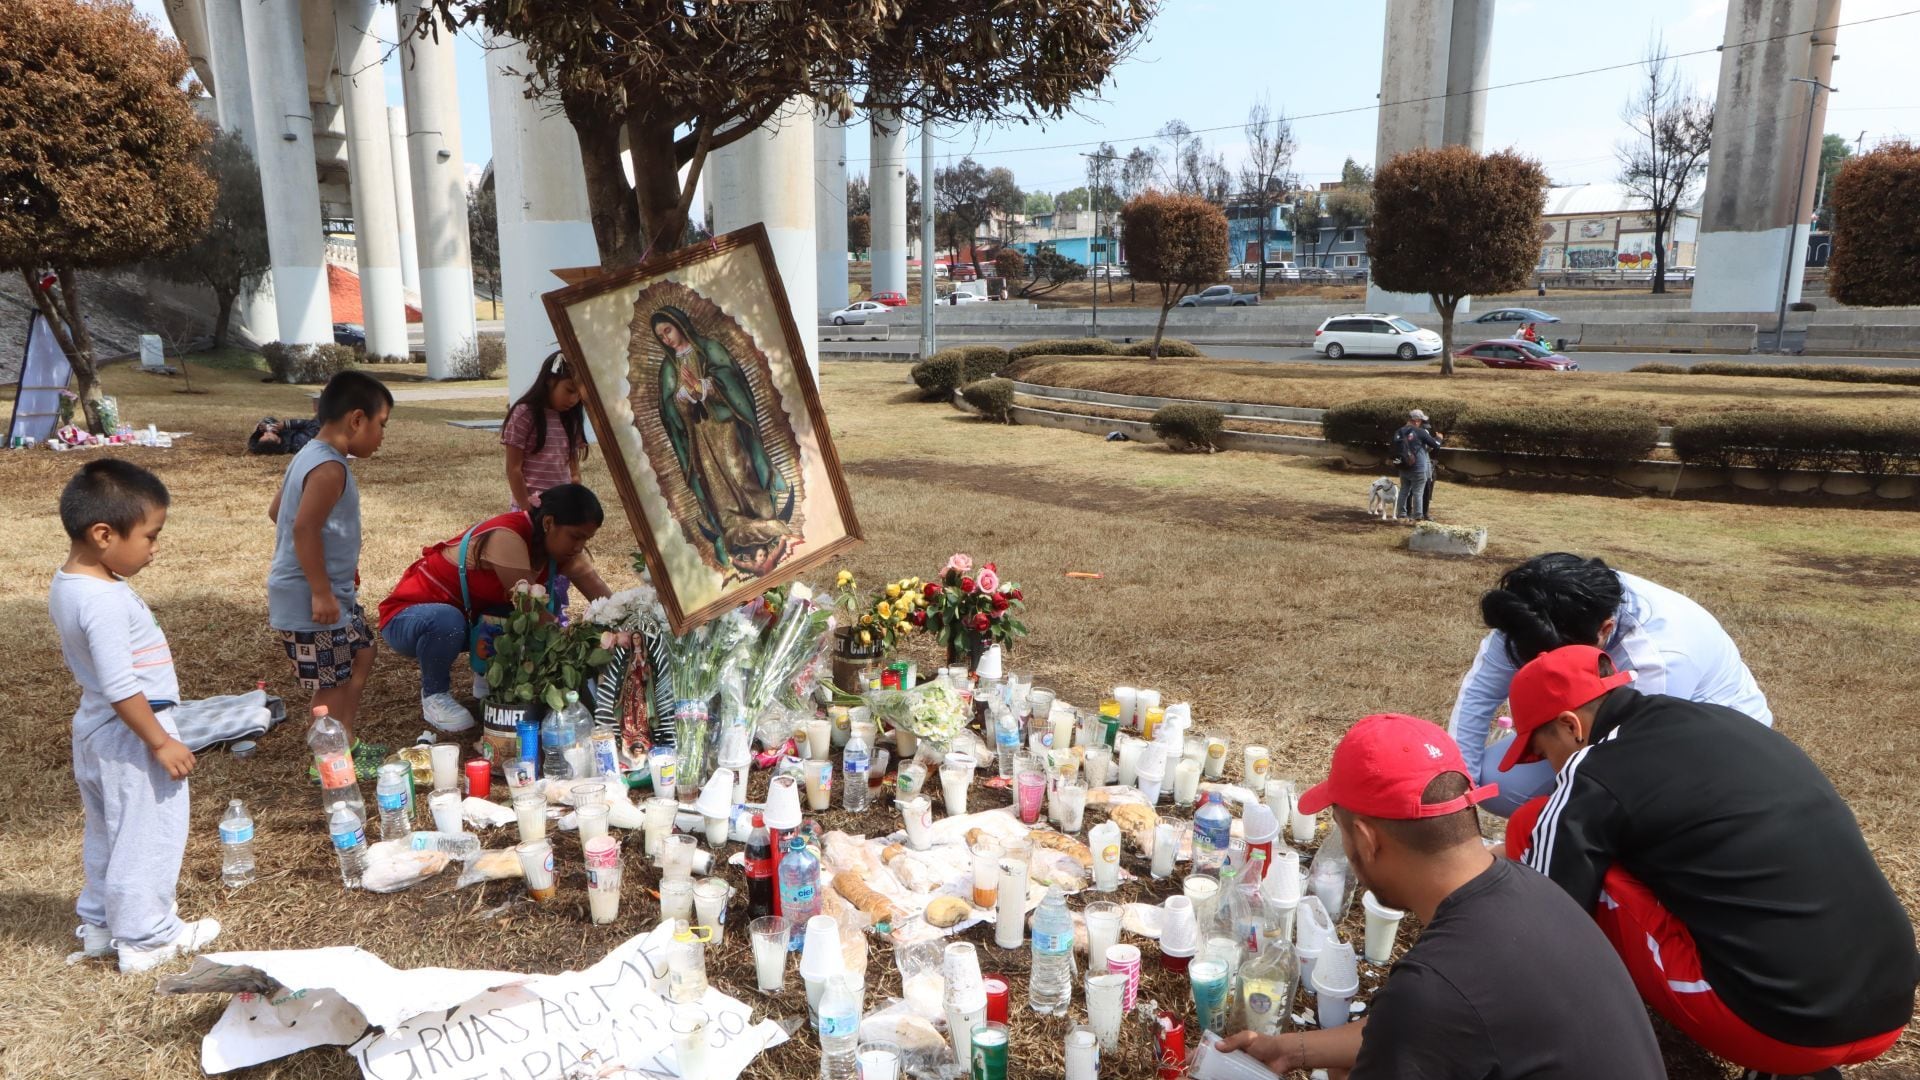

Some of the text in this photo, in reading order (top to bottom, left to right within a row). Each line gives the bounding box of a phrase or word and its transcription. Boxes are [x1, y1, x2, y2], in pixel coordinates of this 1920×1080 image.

[1424, 744, 1443, 759] LA
[798, 887, 813, 897] ciel
[363, 1008, 529, 1080] GRUAS
[539, 946, 669, 1033] ACME
